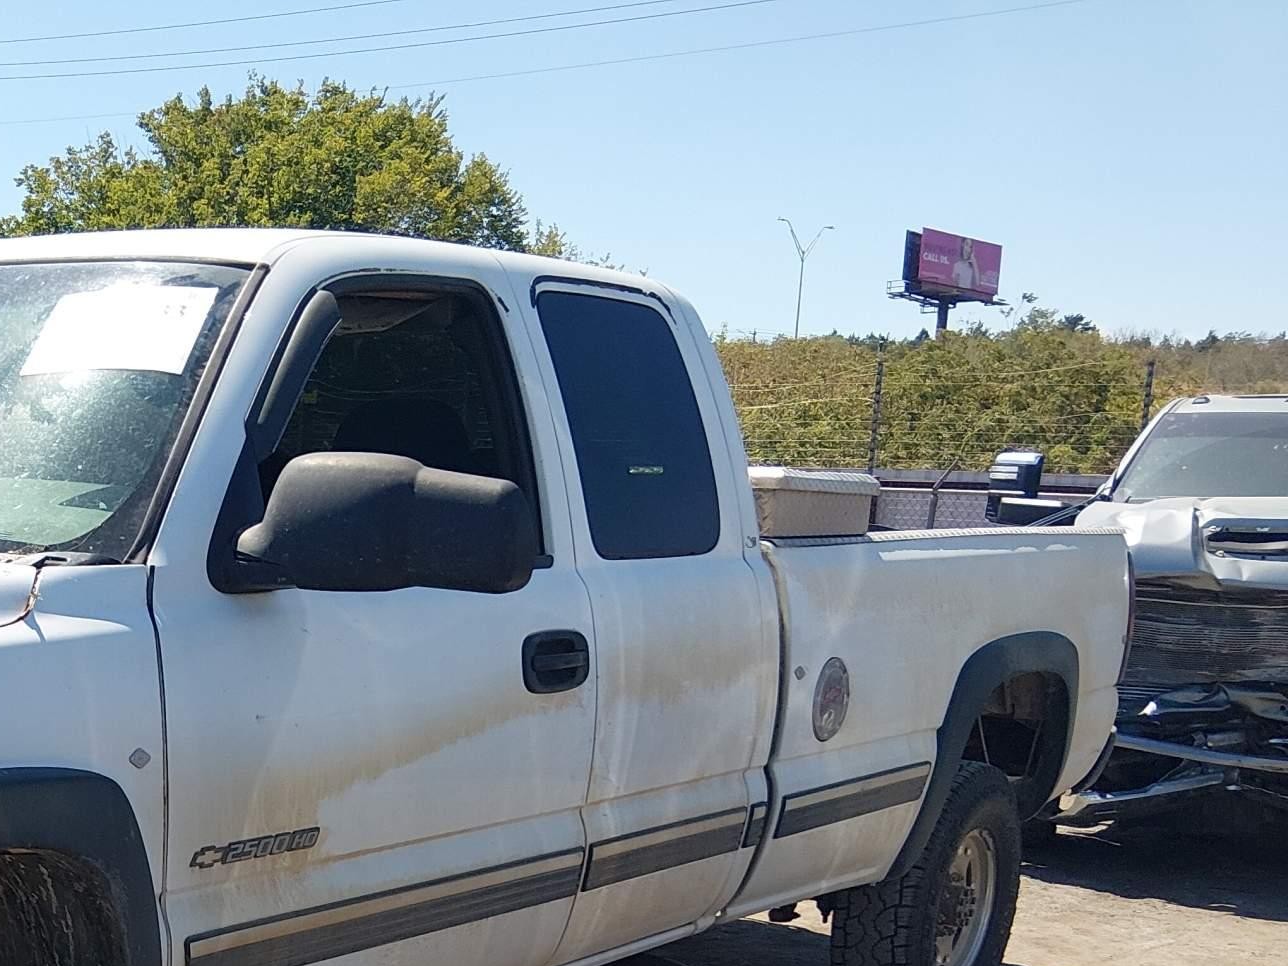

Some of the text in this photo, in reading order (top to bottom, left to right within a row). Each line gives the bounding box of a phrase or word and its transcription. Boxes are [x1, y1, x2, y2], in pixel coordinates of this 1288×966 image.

[922, 251, 939, 263] CALL
[224, 830, 318, 863] 2500 HD
